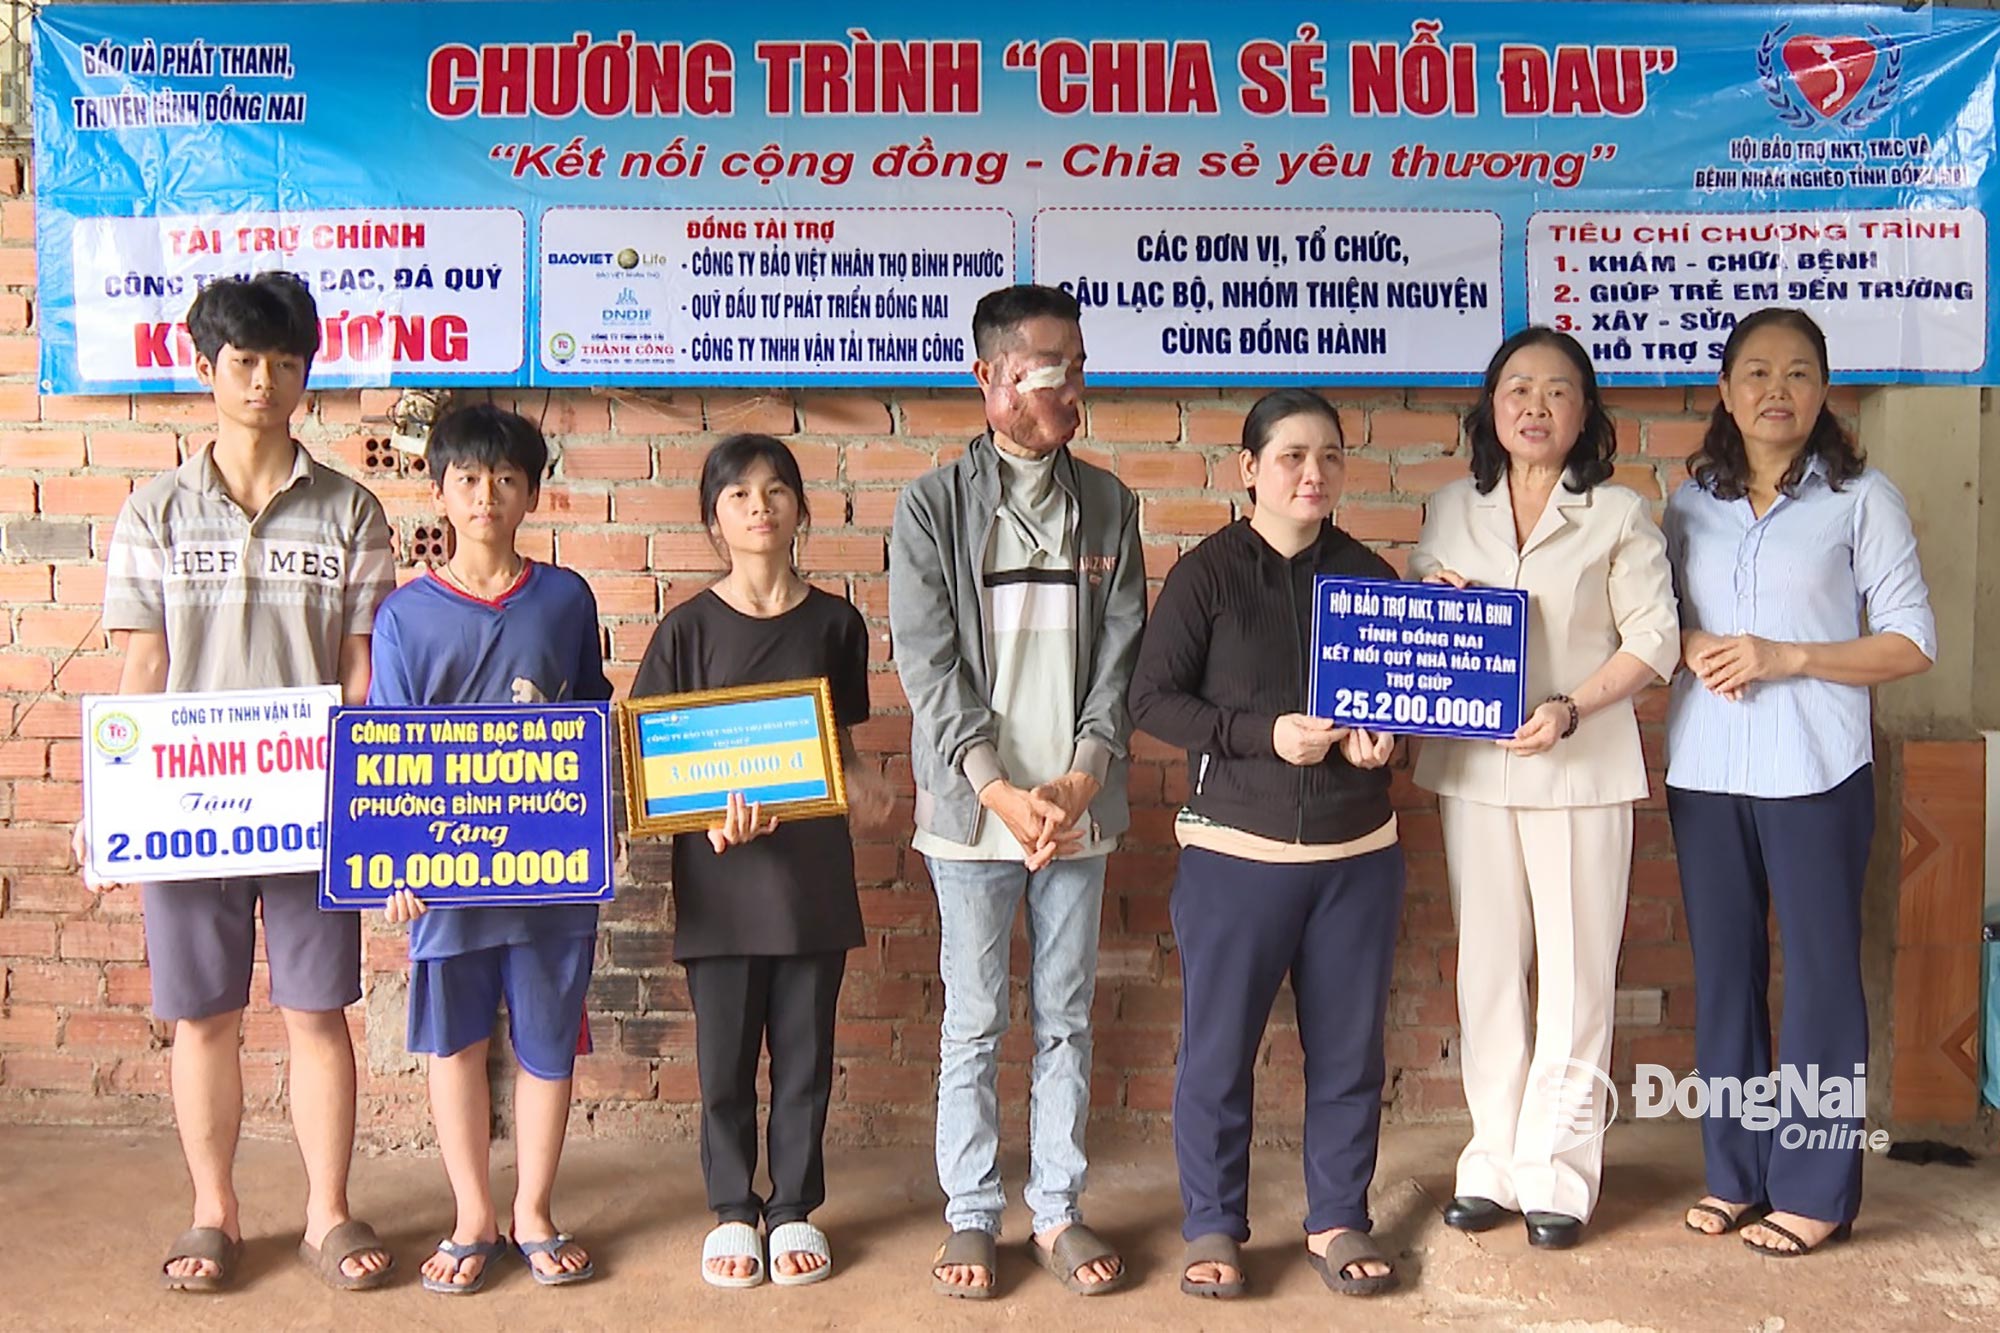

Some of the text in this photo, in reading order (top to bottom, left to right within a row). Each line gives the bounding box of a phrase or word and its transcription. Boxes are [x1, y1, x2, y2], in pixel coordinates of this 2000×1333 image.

[131, 40, 156, 74] VÀ
[161, 40, 215, 75] PHÁT
[219, 45, 293, 77] THANH,
[429, 32, 734, 116] CHƯƠNG
[756, 30, 980, 115] TRÌNH
[1239, 25, 1327, 116] SẺ
[1351, 20, 1477, 117] NỖI
[267, 94, 306, 122] NAI
[619, 137, 707, 179] nối
[720, 144, 855, 185] cộng
[872, 136, 1010, 185] đồng
[1062, 143, 1180, 178] Chia
[1197, 143, 1259, 178] sẻ
[1274, 144, 1369, 185] yêu
[1731, 136, 1932, 164] HỘI BẢO TRỢ NKT, TMC VÀ
[1694, 165, 1739, 191] BỆNH
[1790, 166, 1845, 188] NGHÈO
[168, 219, 425, 256] TÀI TRỢ CHÍNH
[754, 218, 787, 240] TÀI
[794, 220, 836, 243] TRỢ
[1137, 224, 1411, 268] CÁC ĐƠN VỊ, TỔ CHỨC,
[1548, 219, 1963, 245] TIÊU CHÍ CHƯƠNG TRÌNH
[547, 253, 667, 265] BAOVIET Life
[691, 243, 1005, 282] CÔNG TY BẢO VIỆT NHÂN THỌ BÌNH PHƯỚC
[1553, 249, 1879, 281] 1. KHÁM CHỮA BỆNH
[105, 270, 184, 298] CÔNG
[320, 268, 384, 297] BẠC,
[393, 263, 434, 290] ĐÁ
[445, 263, 502, 291] QUÝ
[1116, 280, 1165, 314] LẠC
[1173, 276, 1215, 314] BỘ,
[1222, 277, 1299, 309] NHÓM
[1306, 276, 1379, 314] THIỆN
[1386, 277, 1489, 315] NGUYỆN
[1553, 274, 1975, 303] 2. GIÚP TRẺ EM ĐẾN TRƯỜNG
[691, 289, 721, 320] QUỸ
[760, 291, 781, 319] TƯ
[784, 288, 823, 319] PHÁT
[827, 284, 871, 319] TRIỂN
[921, 294, 949, 319] NAI
[1554, 305, 1738, 333] 3. XÂY SỬA
[133, 309, 469, 368] KI ƯƠNG
[582, 342, 675, 355] THÀNH CÔNG
[691, 329, 965, 367] CÔNG TY TNHH VẬN TẢI THÀNH CÔNG
[1161, 323, 1232, 355] CÙNG
[1316, 323, 1388, 355] HÀNH
[1592, 334, 1633, 362] HỖ
[1642, 340, 1700, 366] TRỢ
[269, 550, 341, 581] MES
[1329, 587, 1513, 627] HỘI BẢO TRỢ NKT, TMC VÀ BNN
[1357, 623, 1398, 644] TỈNH
[1453, 632, 1484, 650] NAI
[1321, 641, 1351, 662] KẾT
[1352, 643, 1380, 665] NỐI
[1415, 650, 1448, 670] NHÀ
[1450, 650, 1482, 672] HẢO
[1484, 655, 1518, 674] TÂM
[1385, 672, 1454, 692] TRỢ GIÚP
[171, 697, 312, 727] CÔNG TY TNHH VẬN TẢI
[1334, 687, 1504, 731] 25.200.000đ
[107, 723, 128, 740] TC
[350, 715, 587, 747] CÔNG TY VÀNG BẠC ĐÁ QUÝ
[151, 735, 247, 780] THÀNH
[355, 747, 580, 787] KIM HƯƠNG
[668, 751, 804, 785] 3.000.000 đ
[179, 791, 254, 815] Tặng
[349, 787, 588, 821] (PHƯỜNG BÌNH PHƯỚC)
[106, 820, 325, 864] 2.000.000đ
[428, 819, 510, 848] Tặng
[344, 847, 591, 891] 10.000.000đ
